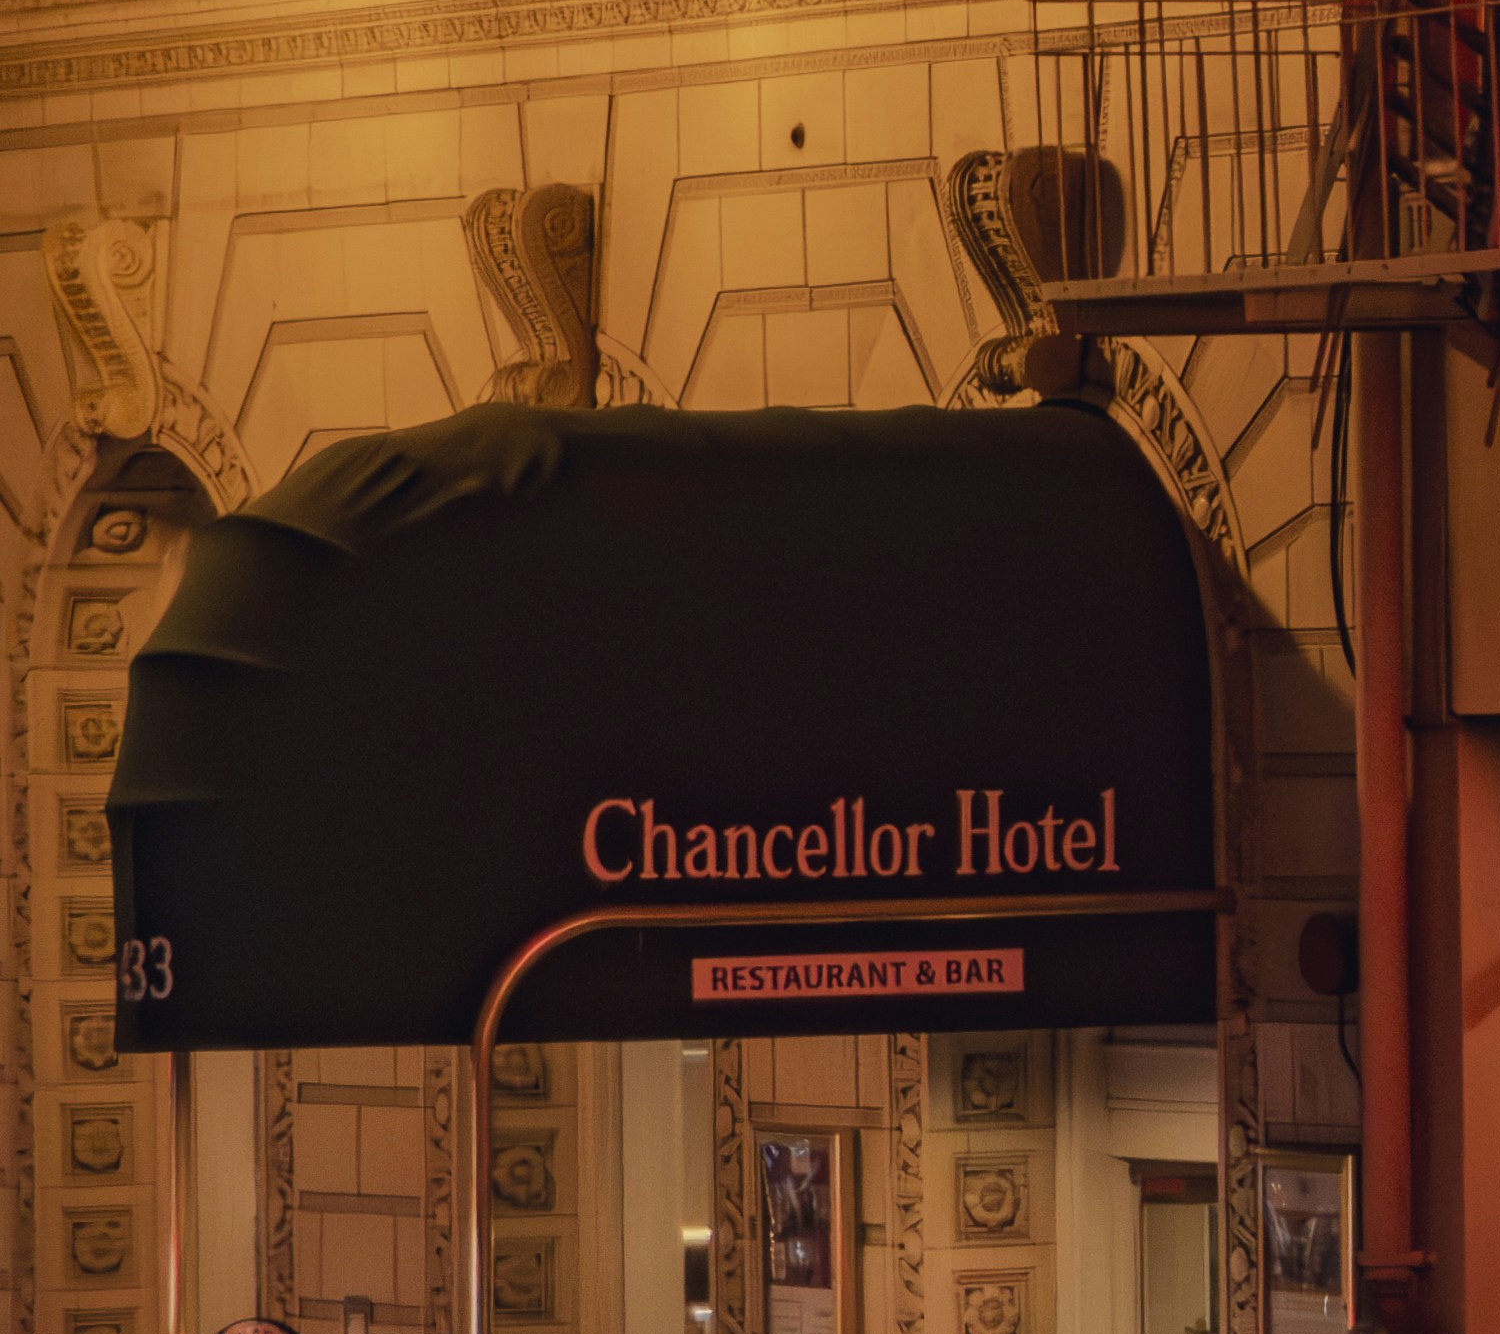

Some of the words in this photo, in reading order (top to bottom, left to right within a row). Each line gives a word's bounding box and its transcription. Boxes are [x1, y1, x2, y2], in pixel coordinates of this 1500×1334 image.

[582, 796, 936, 883] Chancellor
[954, 786, 1122, 876] Hotel
[711, 961, 907, 992] RESTAURANT
[915, 958, 937, 986] &
[945, 957, 1006, 985] BAR
